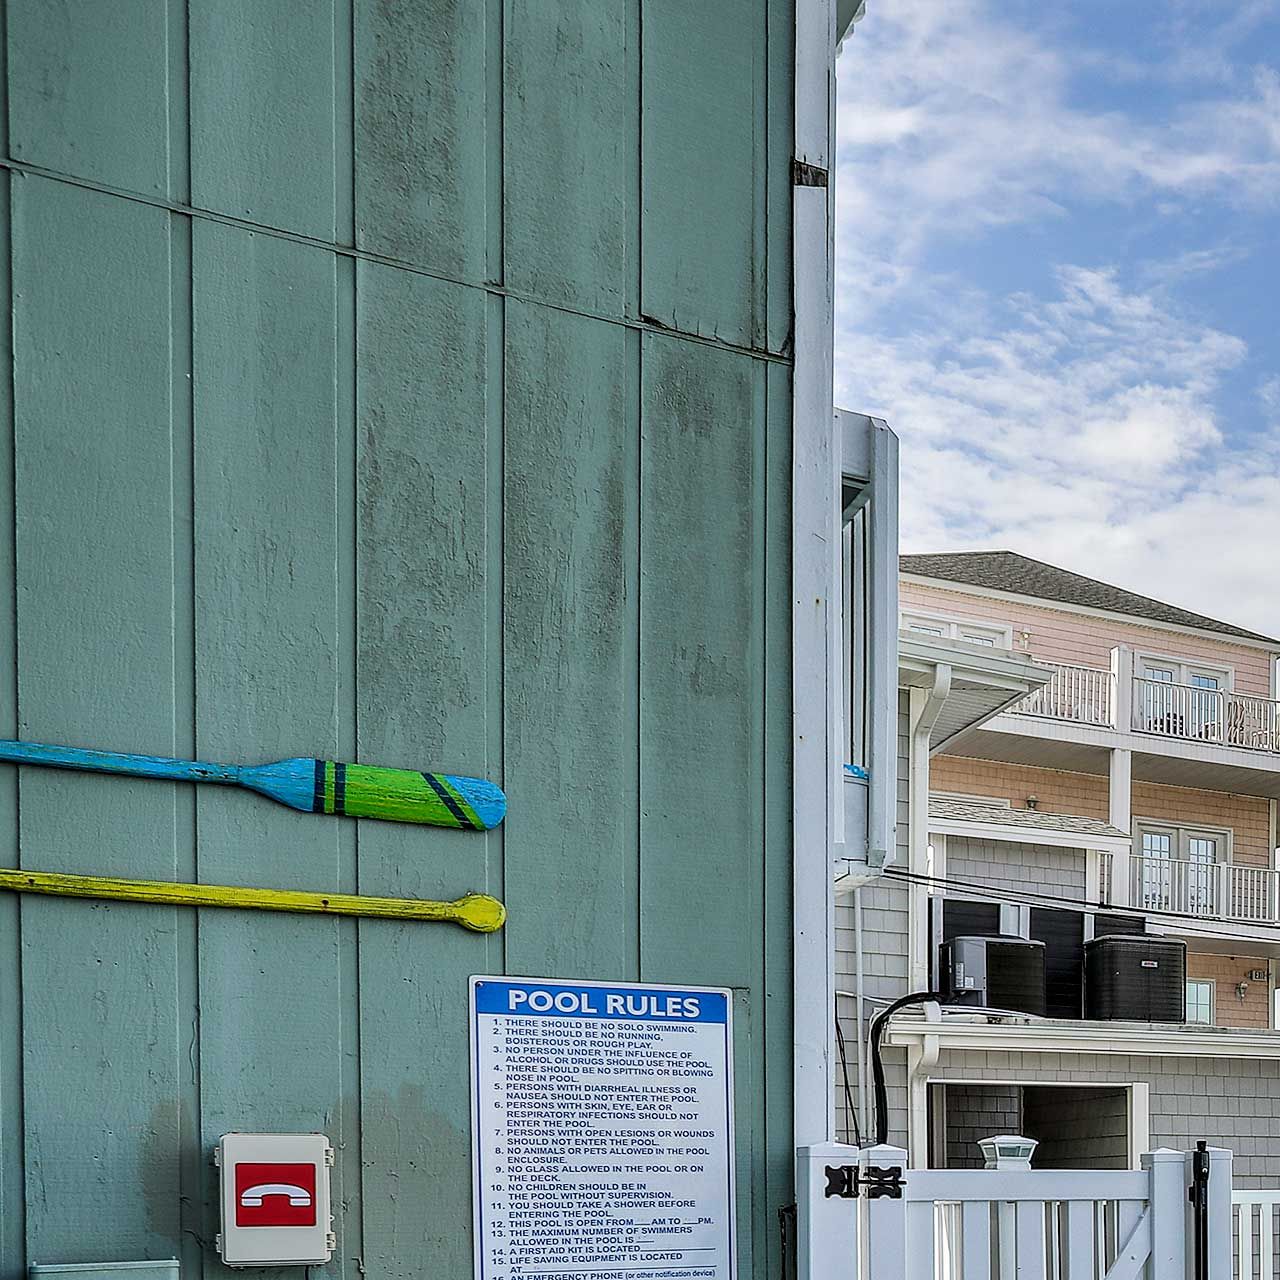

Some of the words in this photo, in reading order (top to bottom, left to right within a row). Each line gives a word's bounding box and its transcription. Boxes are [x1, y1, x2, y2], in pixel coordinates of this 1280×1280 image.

[507, 988, 597, 1014] POOL
[606, 993, 700, 1018] RULES
[505, 1018, 538, 1027] THERE
[541, 1020, 582, 1029] SHOULD
[584, 1021, 597, 1029] BE
[600, 1022, 614, 1030] NO
[617, 1022, 643, 1031] SOLO
[646, 1024, 696, 1033] SWIMMING.
[505, 1027, 538, 1036] THERE
[541, 1029, 582, 1038] SHOULD
[584, 1030, 597, 1038] BE
[600, 1031, 615, 1039] NO
[505, 1036, 570, 1046] BOISTEROUS
[572, 1039, 587, 1047] OR
[589, 1039, 624, 1048] ROUGH
[627, 1040, 652, 1049] PLAY.
[505, 1046, 520, 1054] NO
[523, 1046, 564, 1055] PERSON
[567, 1048, 601, 1056] UNDER
[603, 1049, 622, 1057] THE
[625, 1049, 677, 1058] INFLUENCE
[679, 1051, 692, 1059] OF
[506, 1073, 533, 1081] NOSE
[536, 1074, 546, 1082] IN
[549, 1074, 578, 1082] POOL.
[506, 1082, 554, 1091] PERSONS
[556, 1083, 581, 1091] WITH
[584, 1084, 639, 1093] DIARRHEAL
[641, 1085, 680, 1093] ILLNESS
[682, 1086, 696, 1094] OR
[506, 1091, 547, 1100] NAUSEA
[550, 1092, 591, 1101] SHOULD
[593, 1093, 613, 1101] NOT
[616, 1093, 648, 1102] ENTER
[650, 1094, 668, 1102] THE
[671, 1094, 698, 1102] POOL.
[506, 1101, 554, 1109] PERSONS
[556, 1101, 581, 1109] WITH
[658, 1103, 672, 1111] OR
[506, 1110, 576, 1118] RESPIRATORY
[578, 1111, 635, 1119] INFECTIONS
[638, 1112, 677, 1120] SHOULD
[679, 1112, 698, 1120] NOT
[506, 1119, 540, 1127] ENTER
[542, 1119, 562, 1127] THE
[506, 1128, 555, 1136] PERSONS
[584, 1129, 611, 1137] OPEN
[614, 1129, 655, 1137] LESIONS
[507, 1137, 548, 1145] SHOULD
[609, 1138, 628, 1146] THE
[630, 1138, 659, 1146] POOL.
[507, 1165, 522, 1173] NO
[525, 1165, 558, 1173] GLASS
[507, 1174, 527, 1182] THE
[530, 1174, 560, 1182] DECK.
[508, 1183, 522, 1191] NO
[525, 1183, 575, 1191] CHILDREN
[578, 1182, 618, 1190] SHOULD
[621, 1182, 634, 1190] BE
[636, 1182, 646, 1190] IN
[508, 1192, 527, 1200] THE
[530, 1192, 558, 1200] POOL
[560, 1191, 605, 1200] WITHOUT
[607, 1191, 673, 1199] SUPERVISION.
[508, 1201, 529, 1209] YOU
[532, 1201, 573, 1209] SHOULD
[575, 1200, 601, 1208] TAKE
[604, 1200, 611, 1208] A
[613, 1200, 655, 1208] SHOWER
[657, 1199, 695, 1207] BEFORE
[508, 1210, 559, 1218] ENTERING
[561, 1210, 581, 1218] THE
[583, 1209, 613, 1217] POOL.
[508, 1219, 531, 1228] THIS
[534, 1219, 561, 1227] POOL
[564, 1219, 573, 1227] IS
[576, 1218, 603, 1226] OPEN
[651, 1217, 667, 1225] AM
[668, 1217, 680, 1225] TO
[509, 1229, 528, 1237] THE
[531, 1228, 579, 1236] MAXIMUM
[581, 1227, 623, 1235] NUMBER
[641, 1226, 692, 1234] SWIMMERS
[509, 1237, 558, 1246] ALLOWED
[561, 1237, 571, 1245] IN
[573, 1236, 593, 1245] THE
[595, 1236, 622, 1244] POOL
[509, 1247, 516, 1255] A
[519, 1246, 546, 1255] FIRST
[548, 1246, 565, 1254] AID
[567, 1246, 582, 1254] KIT
[585, 1245, 594, 1253] IS
[596, 1244, 641, 1253] LOCATED
[509, 1256, 530, 1264] LIFE
[533, 1255, 568, 1264] SAVING
[571, 1253, 626, 1262] EQUIPMENT
[628, 1253, 637, 1261] IS
[639, 1252, 682, 1261] LOCATED
[590, 1271, 623, 1280] PHONE
